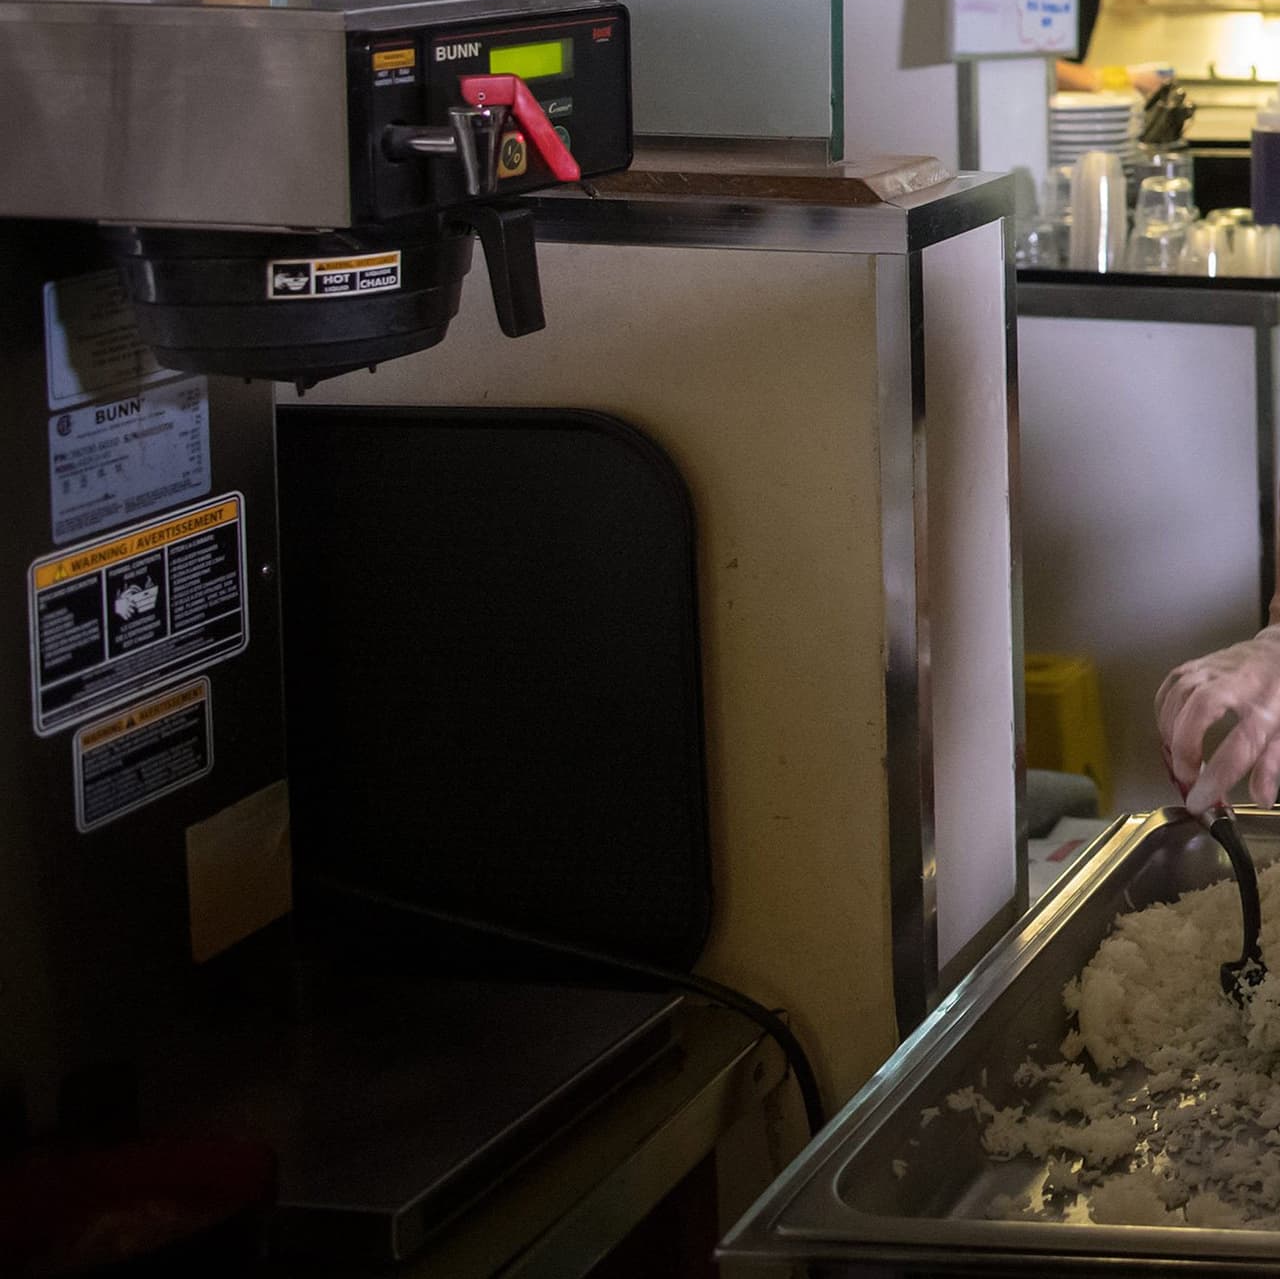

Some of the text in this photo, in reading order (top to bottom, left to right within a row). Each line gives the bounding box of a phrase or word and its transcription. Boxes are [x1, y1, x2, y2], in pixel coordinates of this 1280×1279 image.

[436, 43, 480, 61] BUNN
[322, 274, 351, 285] HOT
[360, 275, 397, 289] CHAUD
[95, 400, 141, 424] BUNN
[70, 542, 128, 571] WARNING
[136, 509, 224, 548] AVERTISSEMENT
